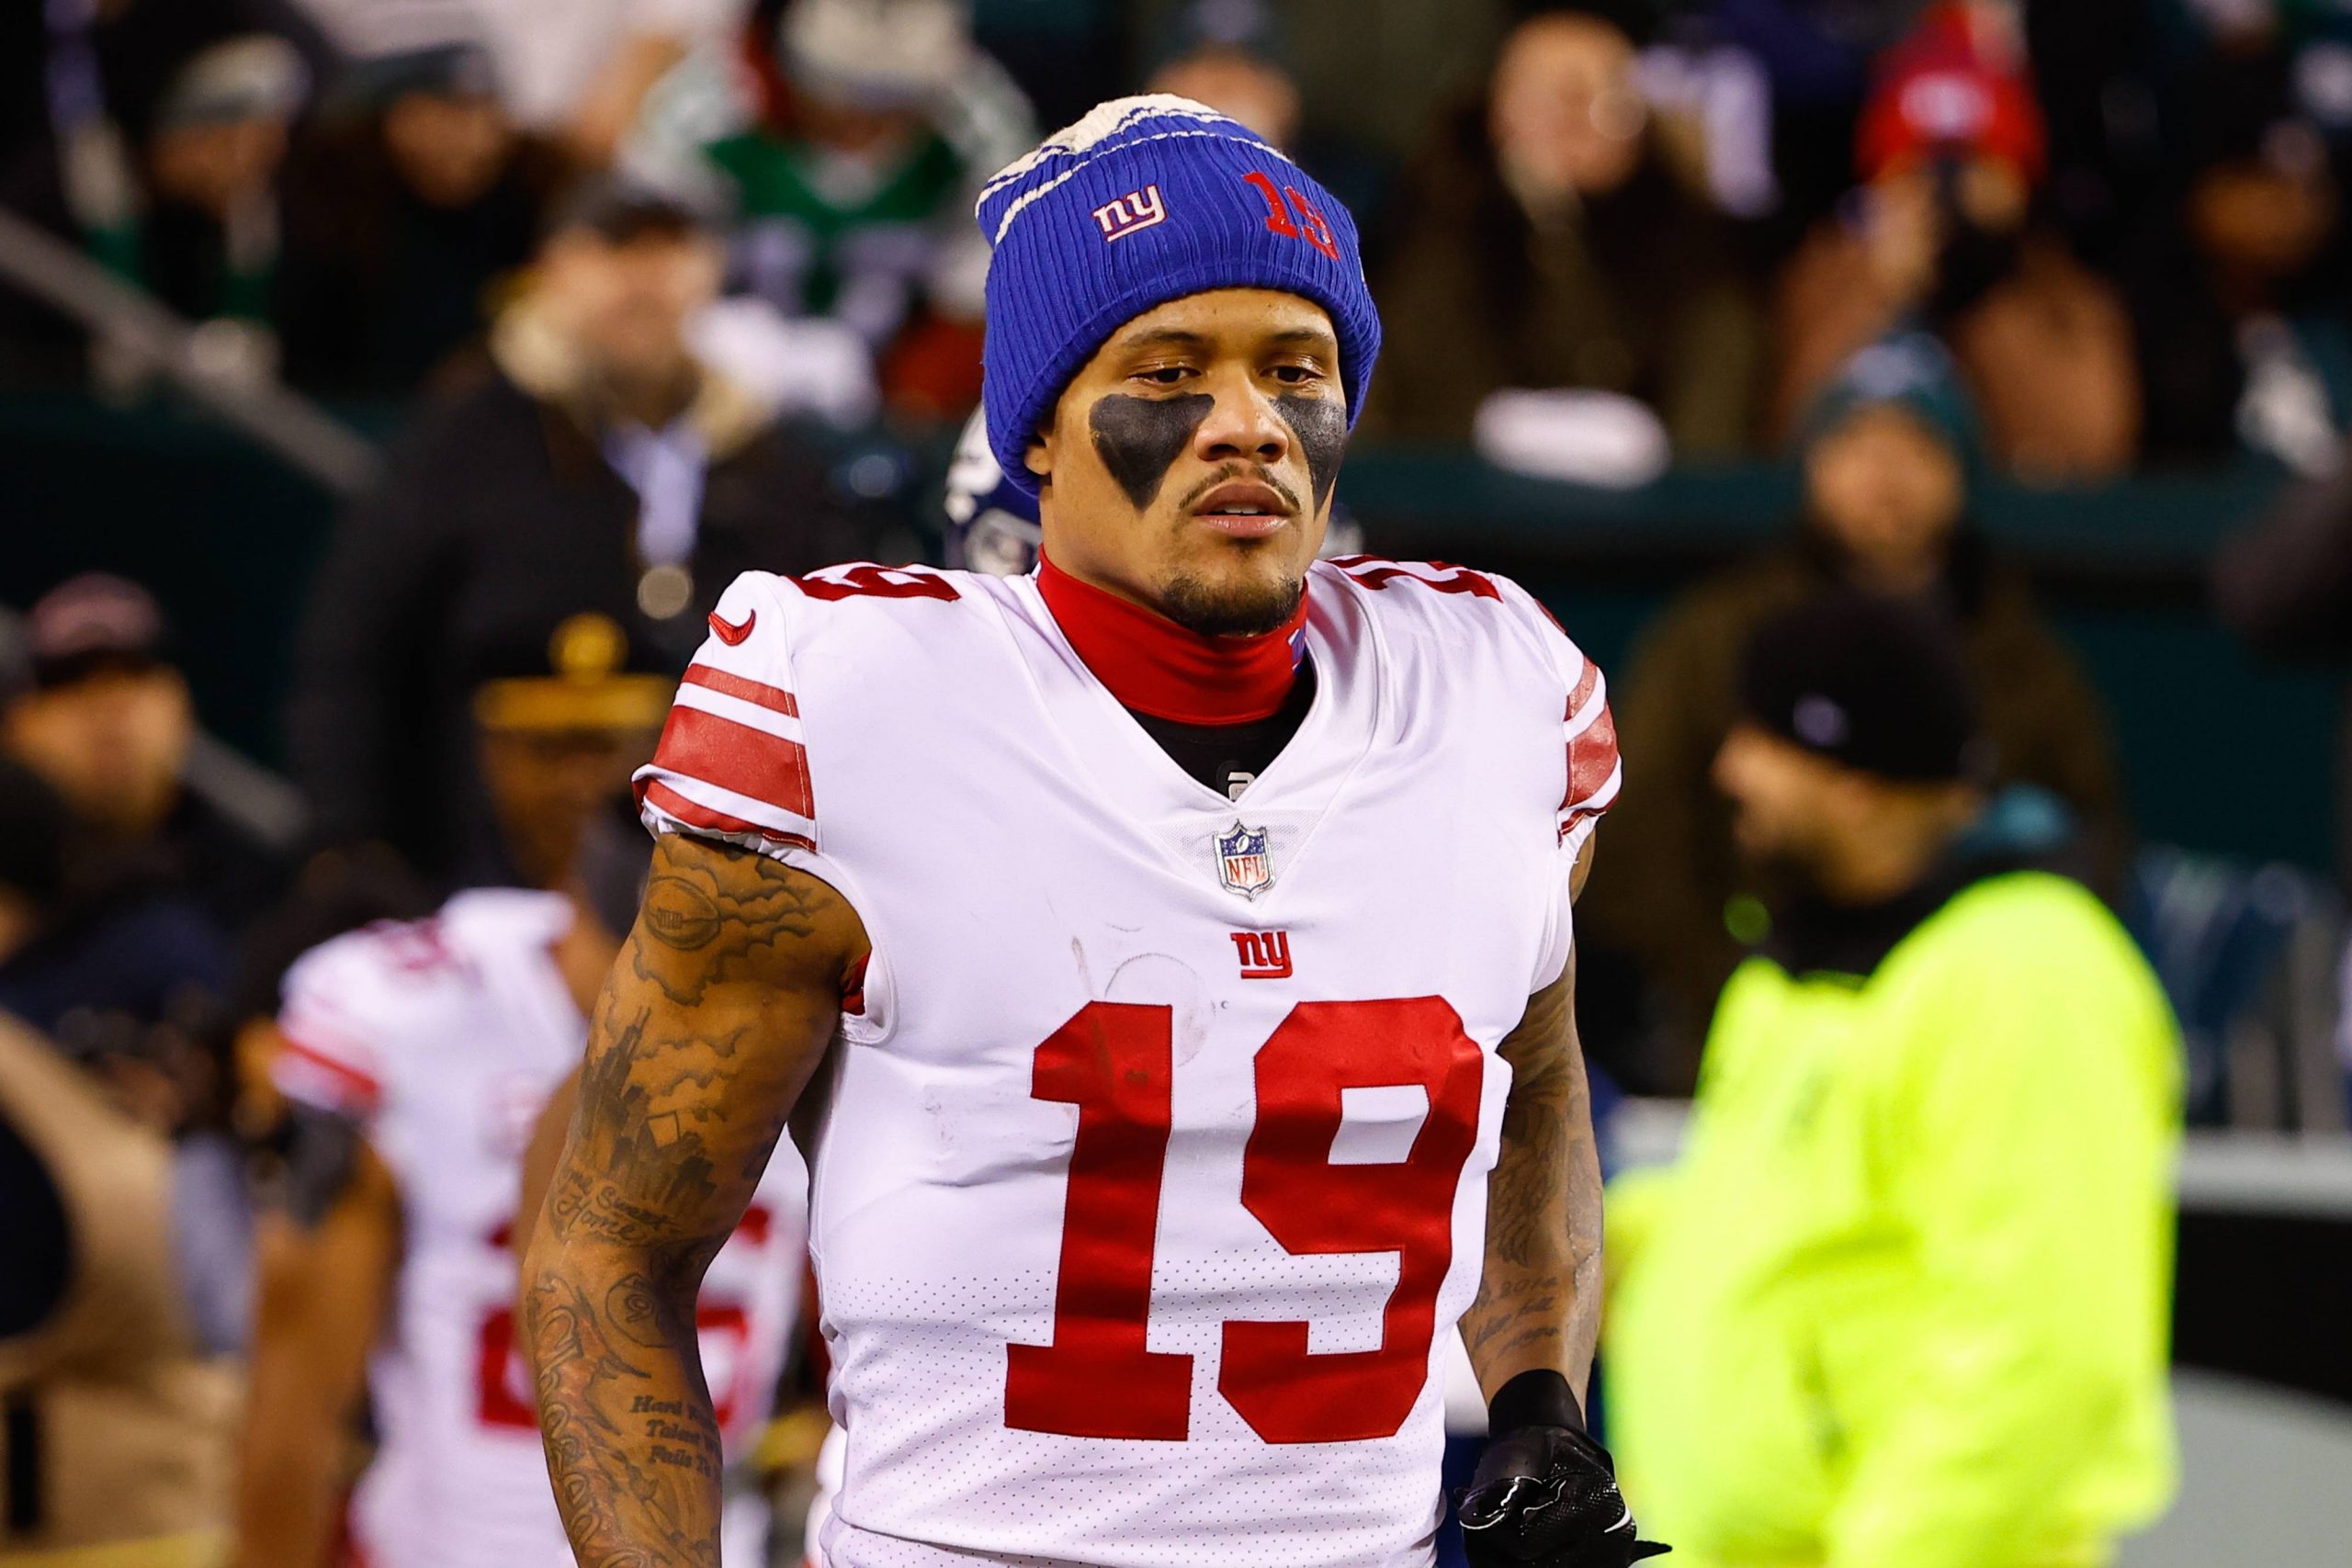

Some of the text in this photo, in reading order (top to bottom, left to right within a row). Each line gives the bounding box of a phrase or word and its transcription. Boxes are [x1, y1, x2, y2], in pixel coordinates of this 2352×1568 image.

[1091, 185, 1169, 243] ny
[1243, 171, 1340, 262] 19
[1226, 854, 1266, 884] NFL
[1230, 931, 1293, 979] ny
[1004, 994, 1484, 1445] 19
